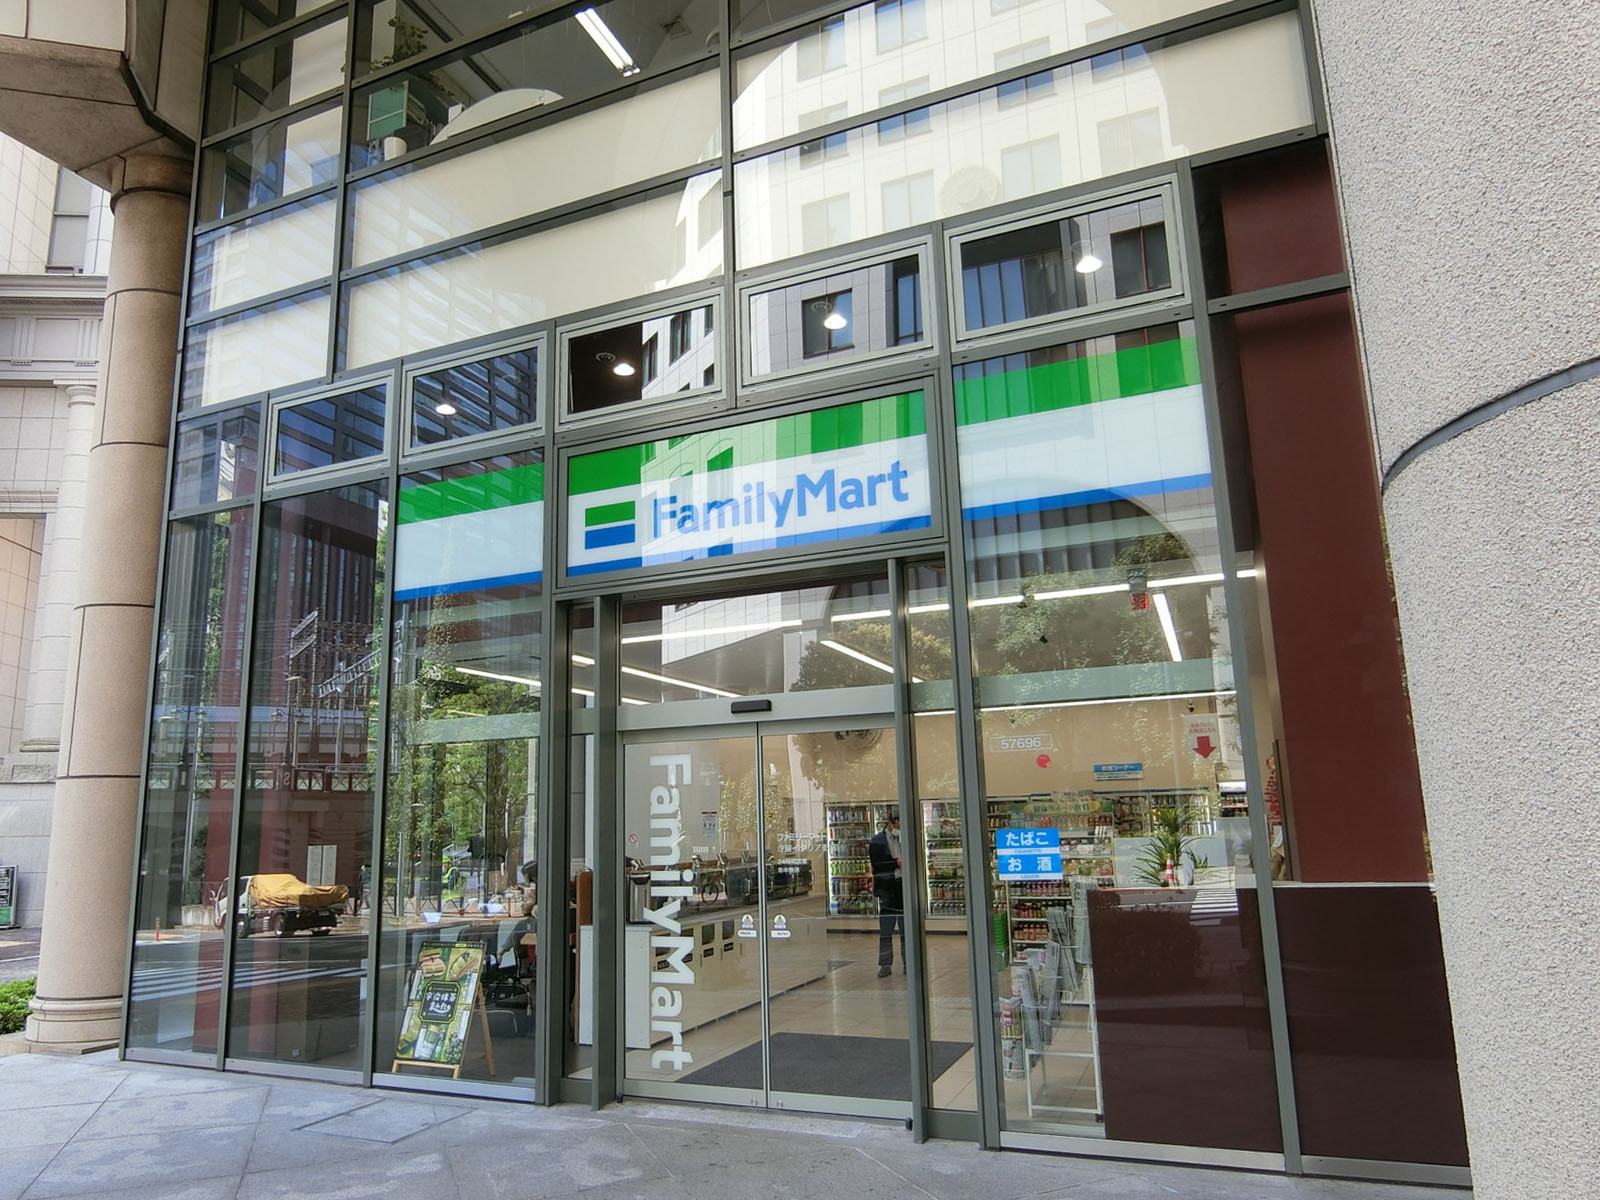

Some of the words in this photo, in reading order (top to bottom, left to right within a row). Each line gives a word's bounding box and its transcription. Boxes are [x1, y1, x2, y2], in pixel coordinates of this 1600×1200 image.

[653, 460, 909, 539] FamilyMart
[1000, 737, 1042, 750] 57696
[1005, 831, 1049, 846] たばこ
[1008, 856, 1053, 872] お酒
[643, 754, 696, 1072] FamilyMart
